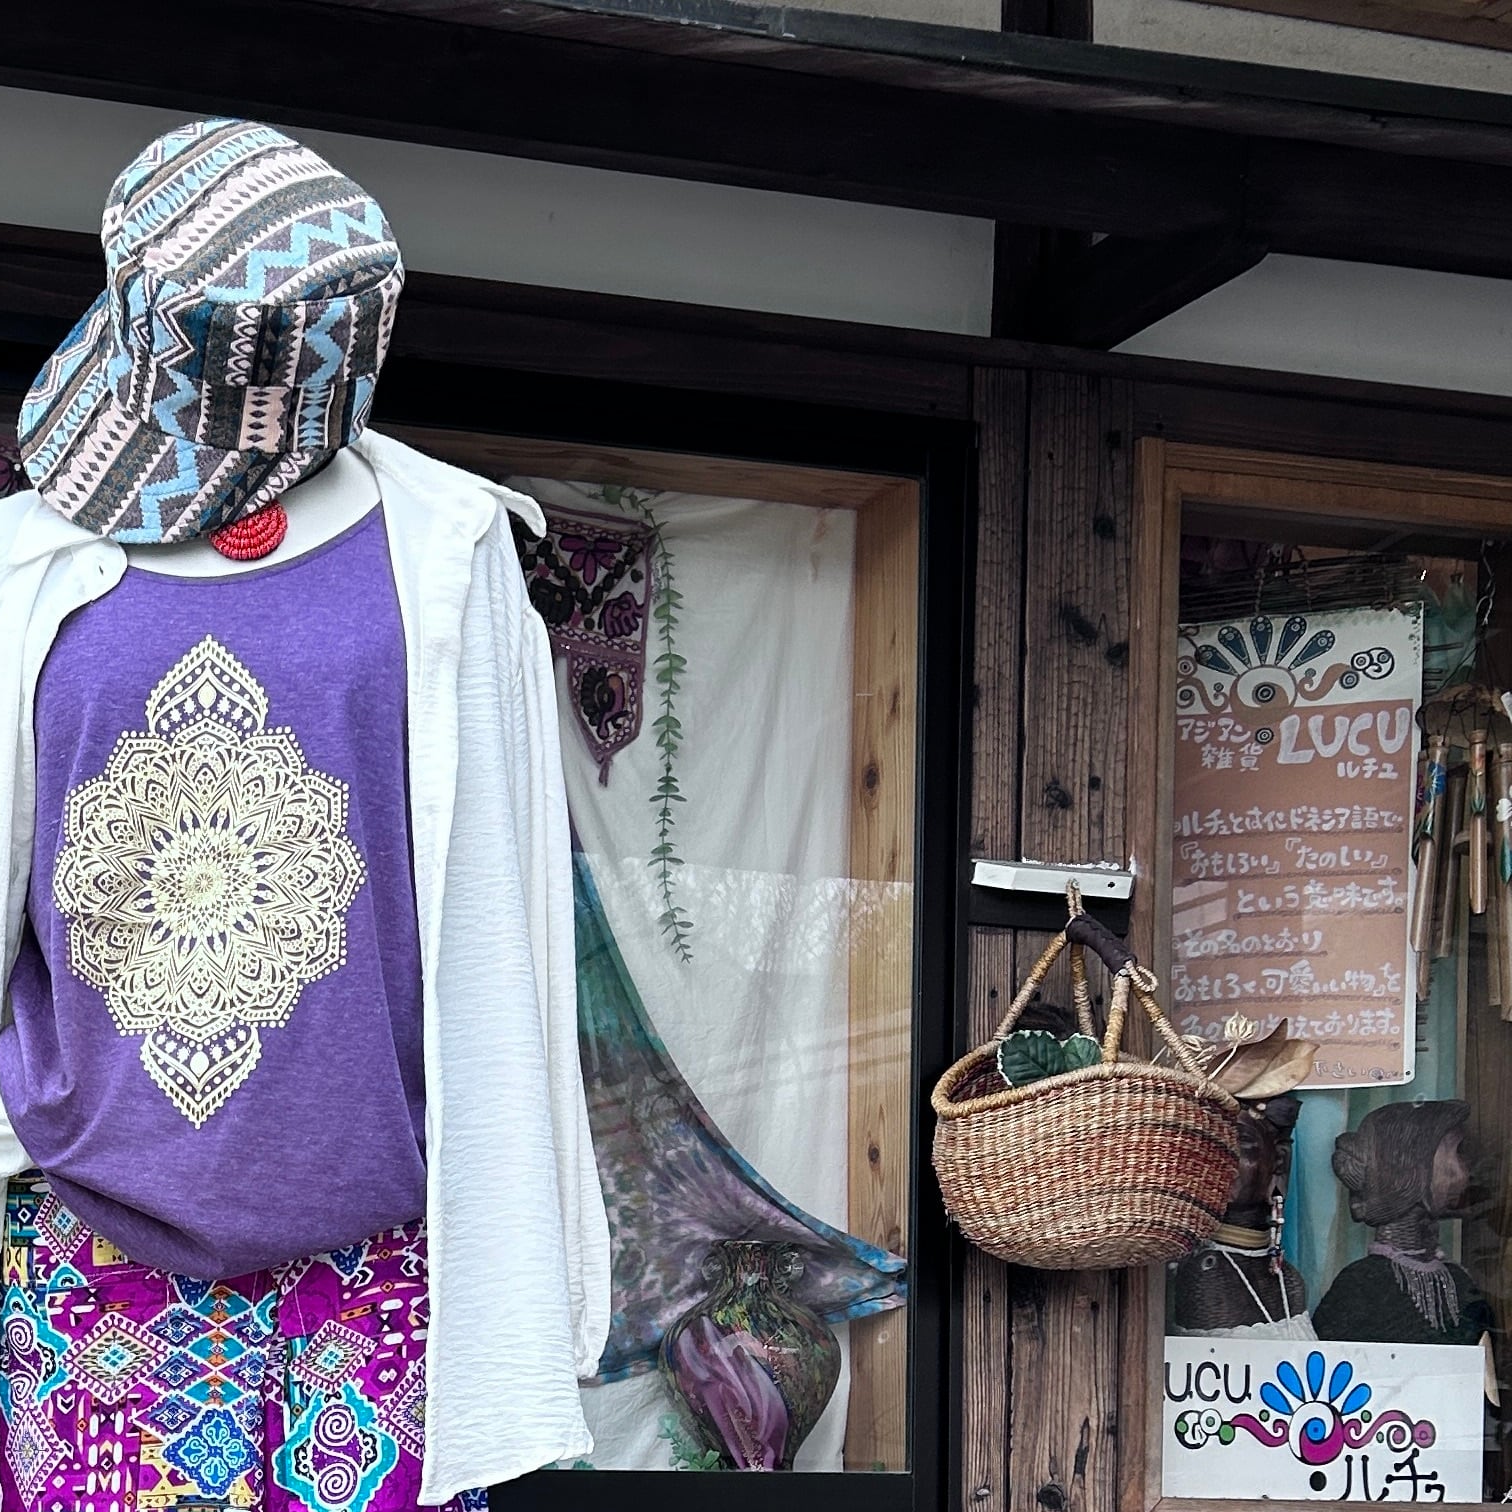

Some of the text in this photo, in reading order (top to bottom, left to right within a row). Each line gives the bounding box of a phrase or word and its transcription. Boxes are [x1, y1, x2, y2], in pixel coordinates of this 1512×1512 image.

[1177, 717, 1252, 744] アジアン
[1277, 707, 1410, 764] LUCU
[1200, 742, 1264, 773] 雑貨
[1336, 757, 1399, 780] ルチュ
[1162, 1361, 1252, 1404] UCU
